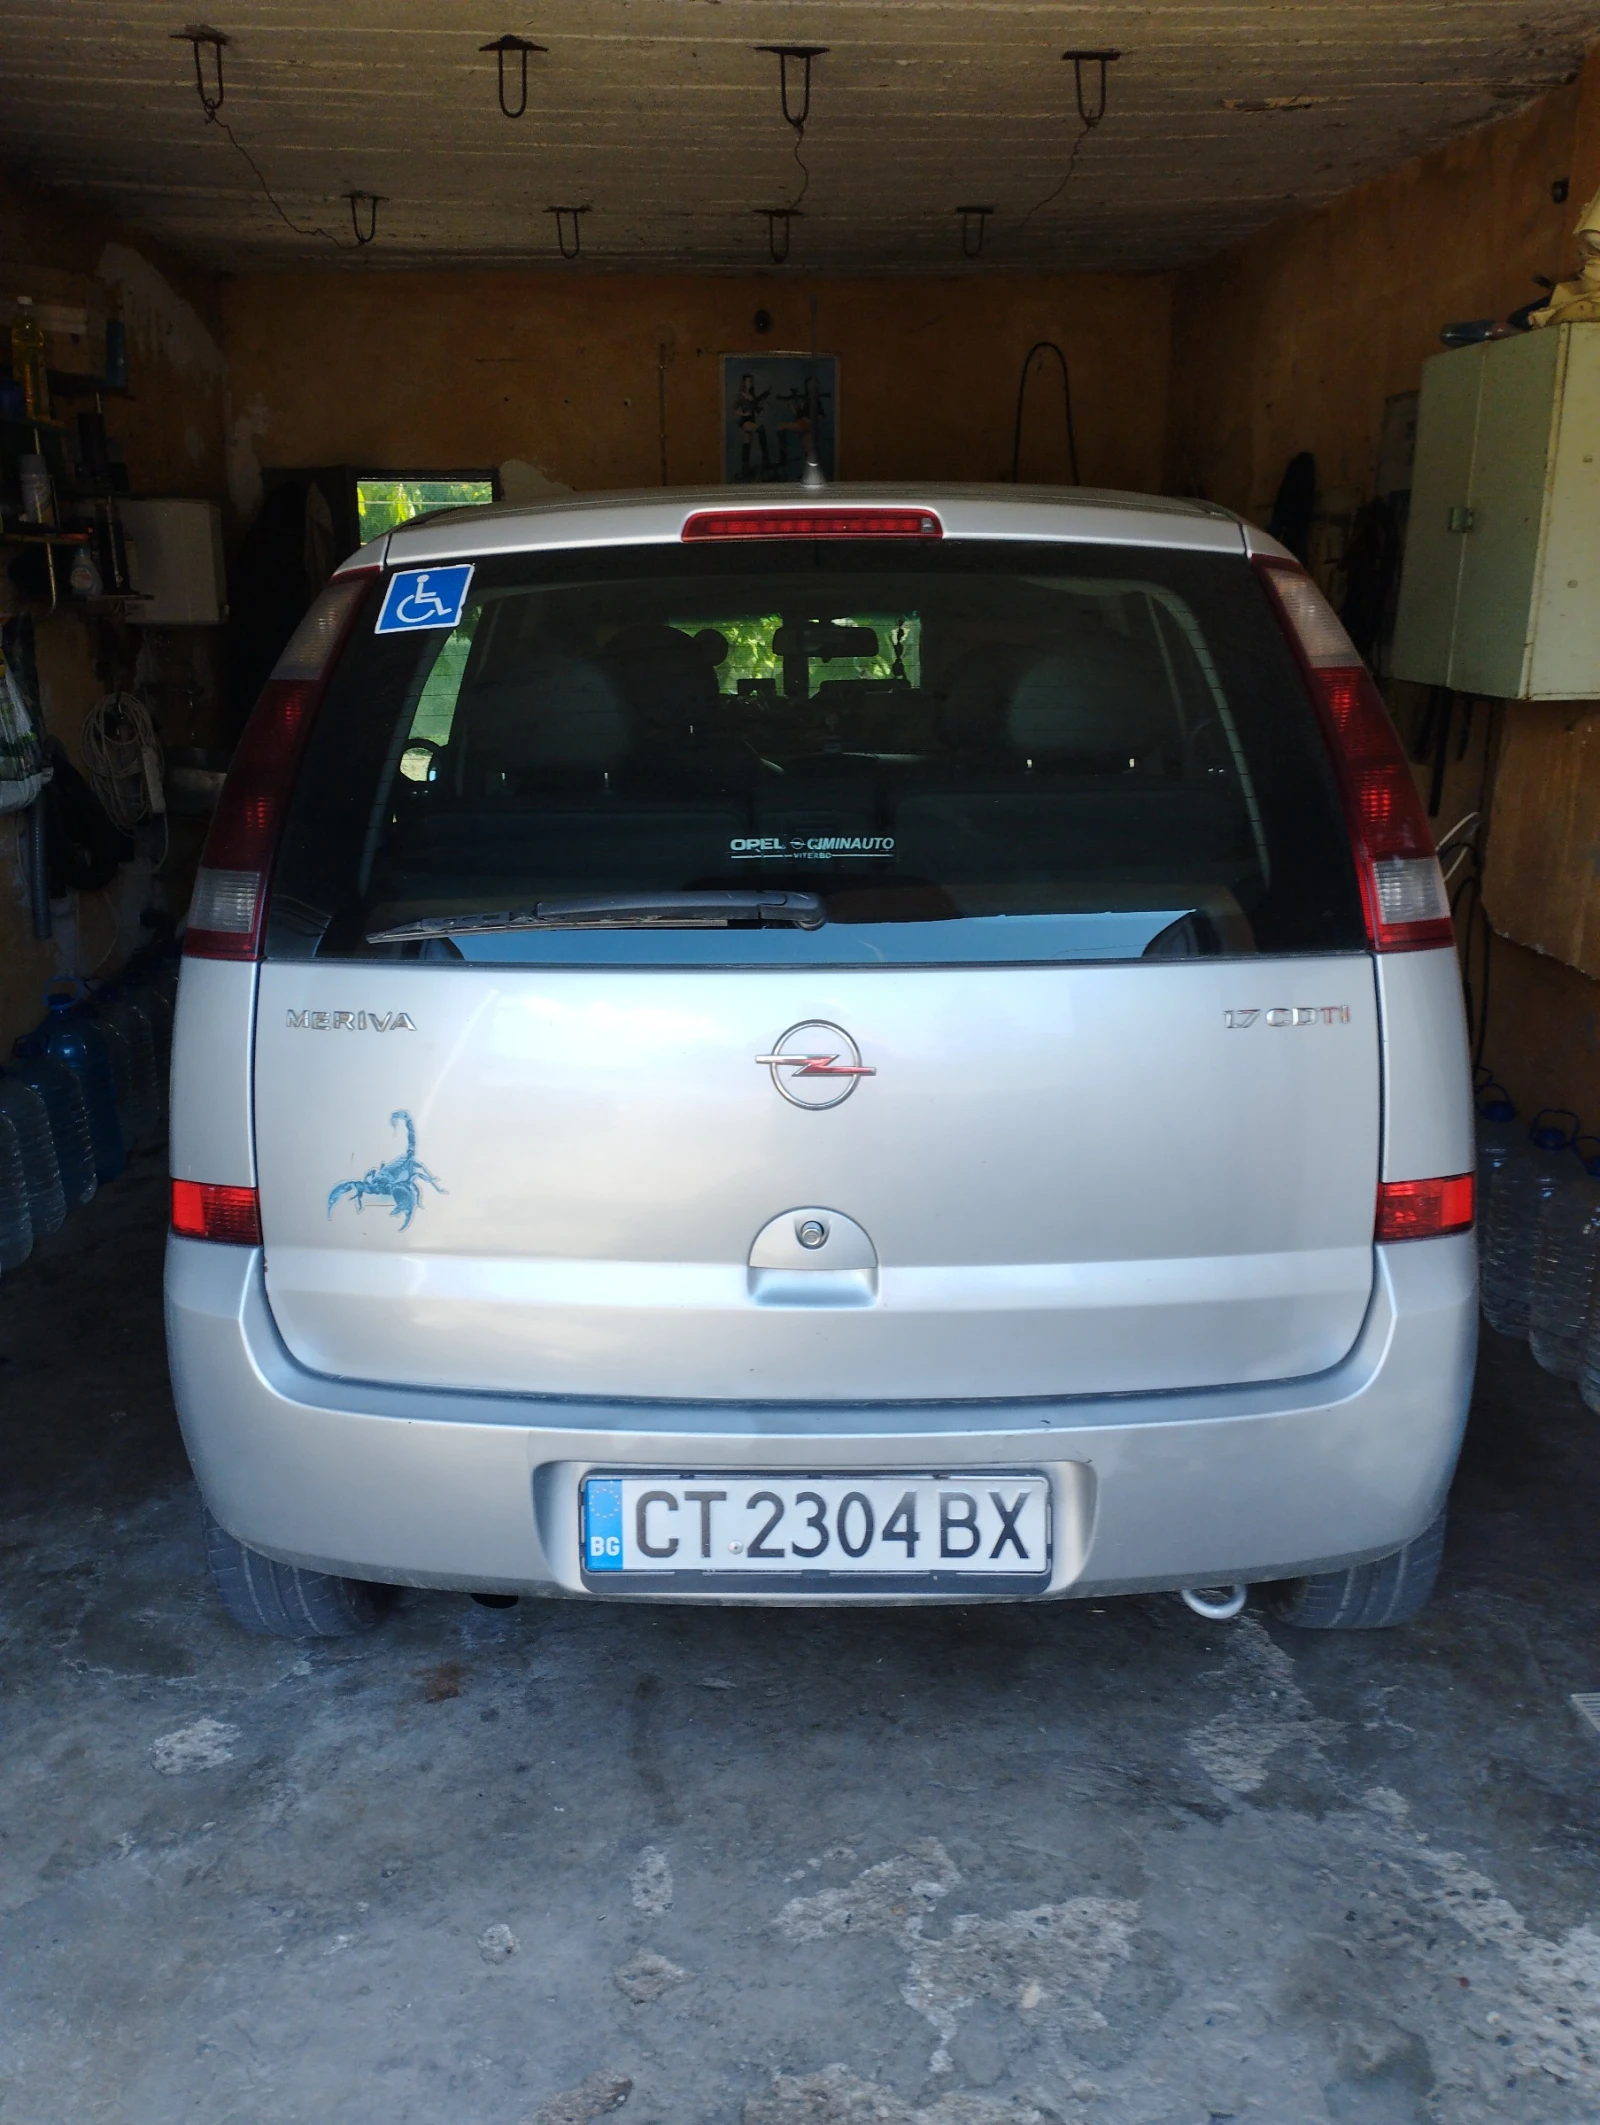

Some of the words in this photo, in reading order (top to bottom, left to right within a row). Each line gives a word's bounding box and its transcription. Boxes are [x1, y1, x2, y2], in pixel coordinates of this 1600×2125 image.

[729, 837, 784, 851] OPEL
[285, 1008, 417, 1032] MERIVA
[1265, 1004, 1351, 1028] CDTI
[635, 1490, 727, 1559] CT
[746, 1491, 921, 1559] 2304
[938, 1490, 1031, 1559] BX
[590, 1536, 620, 1557] BG
